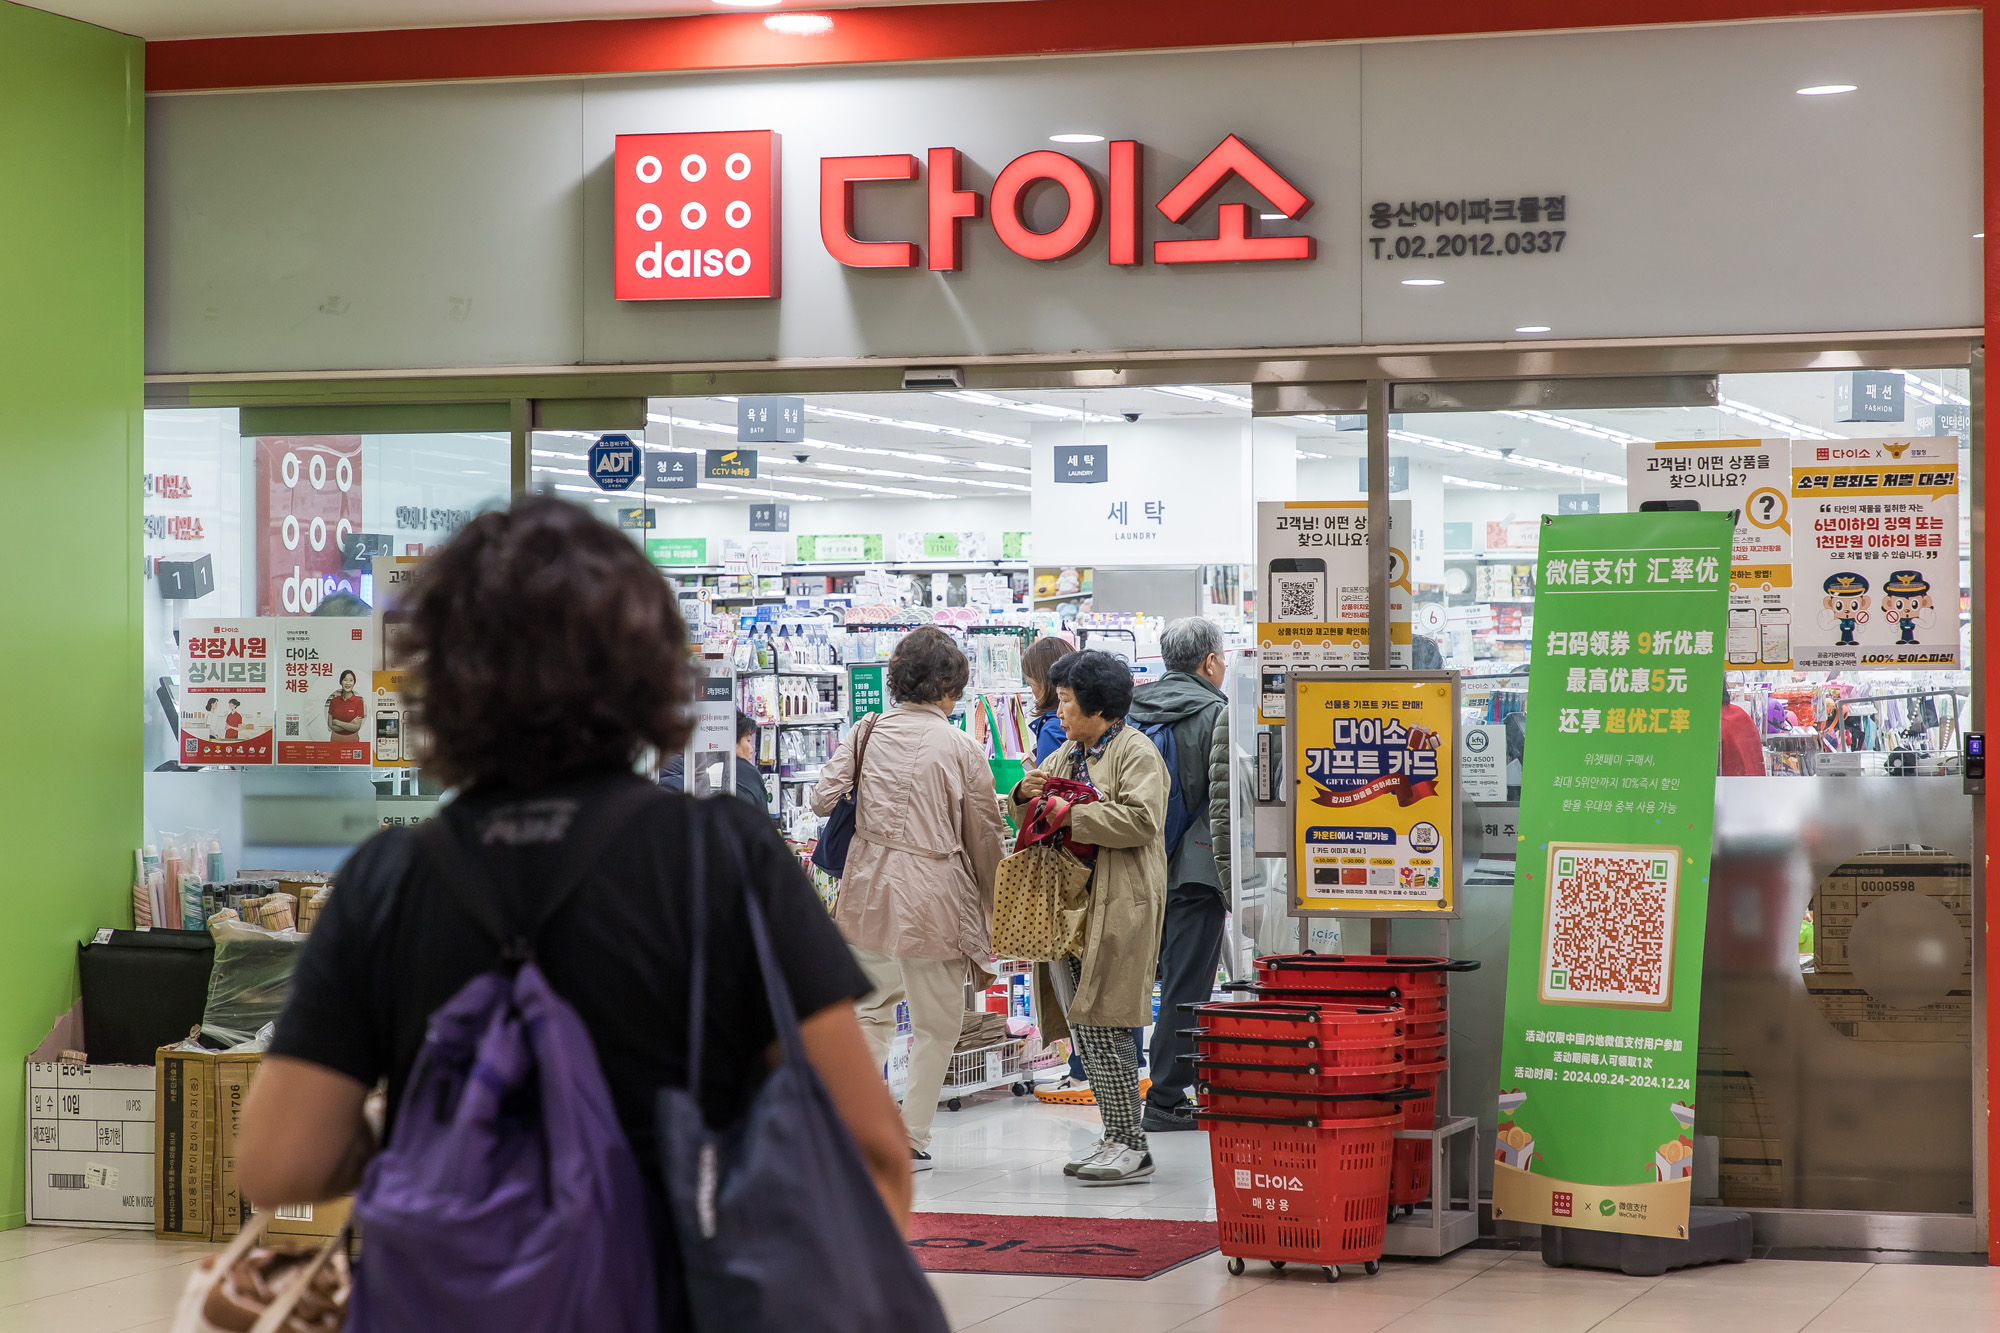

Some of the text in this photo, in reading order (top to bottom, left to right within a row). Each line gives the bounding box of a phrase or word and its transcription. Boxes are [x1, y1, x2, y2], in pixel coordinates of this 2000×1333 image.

[820, 133, 1316, 271] 다이소
[1369, 231, 1567, 260] T.02.2012.0337
[635, 241, 751, 279] daiso
[1866, 384, 1892, 400] 패션
[747, 408, 767, 422] 욕실
[783, 408, 798, 424] 욕실
[1864, 404, 1893, 413] FASHION
[1067, 455, 1095, 467] 세탁
[1832, 449, 1870, 459] 다이소
[597, 452, 633, 473] ADT
[657, 461, 684, 473] 청소
[1646, 454, 1770, 472] 고객님! 어떤 상품을
[1670, 474, 1747, 489] 찾으시나요?
[1797, 472, 1955, 489] 소액 범죄도 처벌 대상!
[1107, 500, 1165, 526] 세탁
[1834, 504, 1924, 513] 타인의 재물을 절취한 자는
[1276, 516, 1350, 530] 고객님! 어떤
[1814, 516, 1943, 532] 6년이하의 징역 또는
[1115, 532, 1157, 540] LAUNDRY
[1298, 533, 1369, 547] 찾으시나요?
[1816, 533, 1942, 548] 1천만원 이하의 벌금
[1847, 551, 1862, 560] 처벌
[1864, 551, 1879, 560] 받을
[1881, 551, 1889, 559] 수
[1891, 551, 1924, 559] 있습니다.
[1545, 557, 1719, 585] 微信支付 汇率优
[1754, 570, 1772, 579] 방법!
[1429, 611, 1438, 624] 6
[1277, 628, 1369, 636] 상품위치와 재고현황 확인하
[188, 637, 267, 658] 현장사원
[1547, 630, 1713, 656] 扫码领券 9折优惠
[286, 648, 319, 660] 다이소
[1861, 653, 1953, 663] 100% 보이스피싱!
[188, 662, 267, 683] 상시모집
[286, 663, 333, 677] 현장 직원
[286, 679, 309, 693] 채용
[1566, 667, 1687, 693] 最高优惠5元
[1325, 700, 1423, 709] 선물용 기프트 카드 판매!
[1558, 707, 1690, 734] 还享 超优汇率
[1335, 720, 1406, 744] 다이소
[1307, 750, 1436, 775] 기프트 카드
[1585, 753, 1655, 767] 위챗페이 구매시,
[1553, 776, 1680, 791] 최대 5위안까지 10%즉시 할인
[1562, 799, 1677, 814] 환율 우대와 중복 사용 가능
[1313, 831, 1388, 840] 카운터에서 구매가능
[1861, 881, 1915, 892] 0000598
[1525, 1030, 1683, 1052] 活动仅限中国内地微信支付用户参加
[1553, 1051, 1653, 1069] 活动期间每人可领取1次
[62, 1094, 80, 1115] 10입
[132, 1100, 141, 1111] PCS
[33, 1126, 56, 1143] 제조일자
[99, 1127, 120, 1146] 유통기한
[1255, 1174, 1303, 1192] 다이소
[123, 1195, 135, 1207] MADE
[136, 1196, 140, 1207] IN
[1252, 1197, 1289, 1211] 매장용
[1619, 1202, 1647, 1213] 微信支付
[1554, 1207, 1570, 1215] daiso
